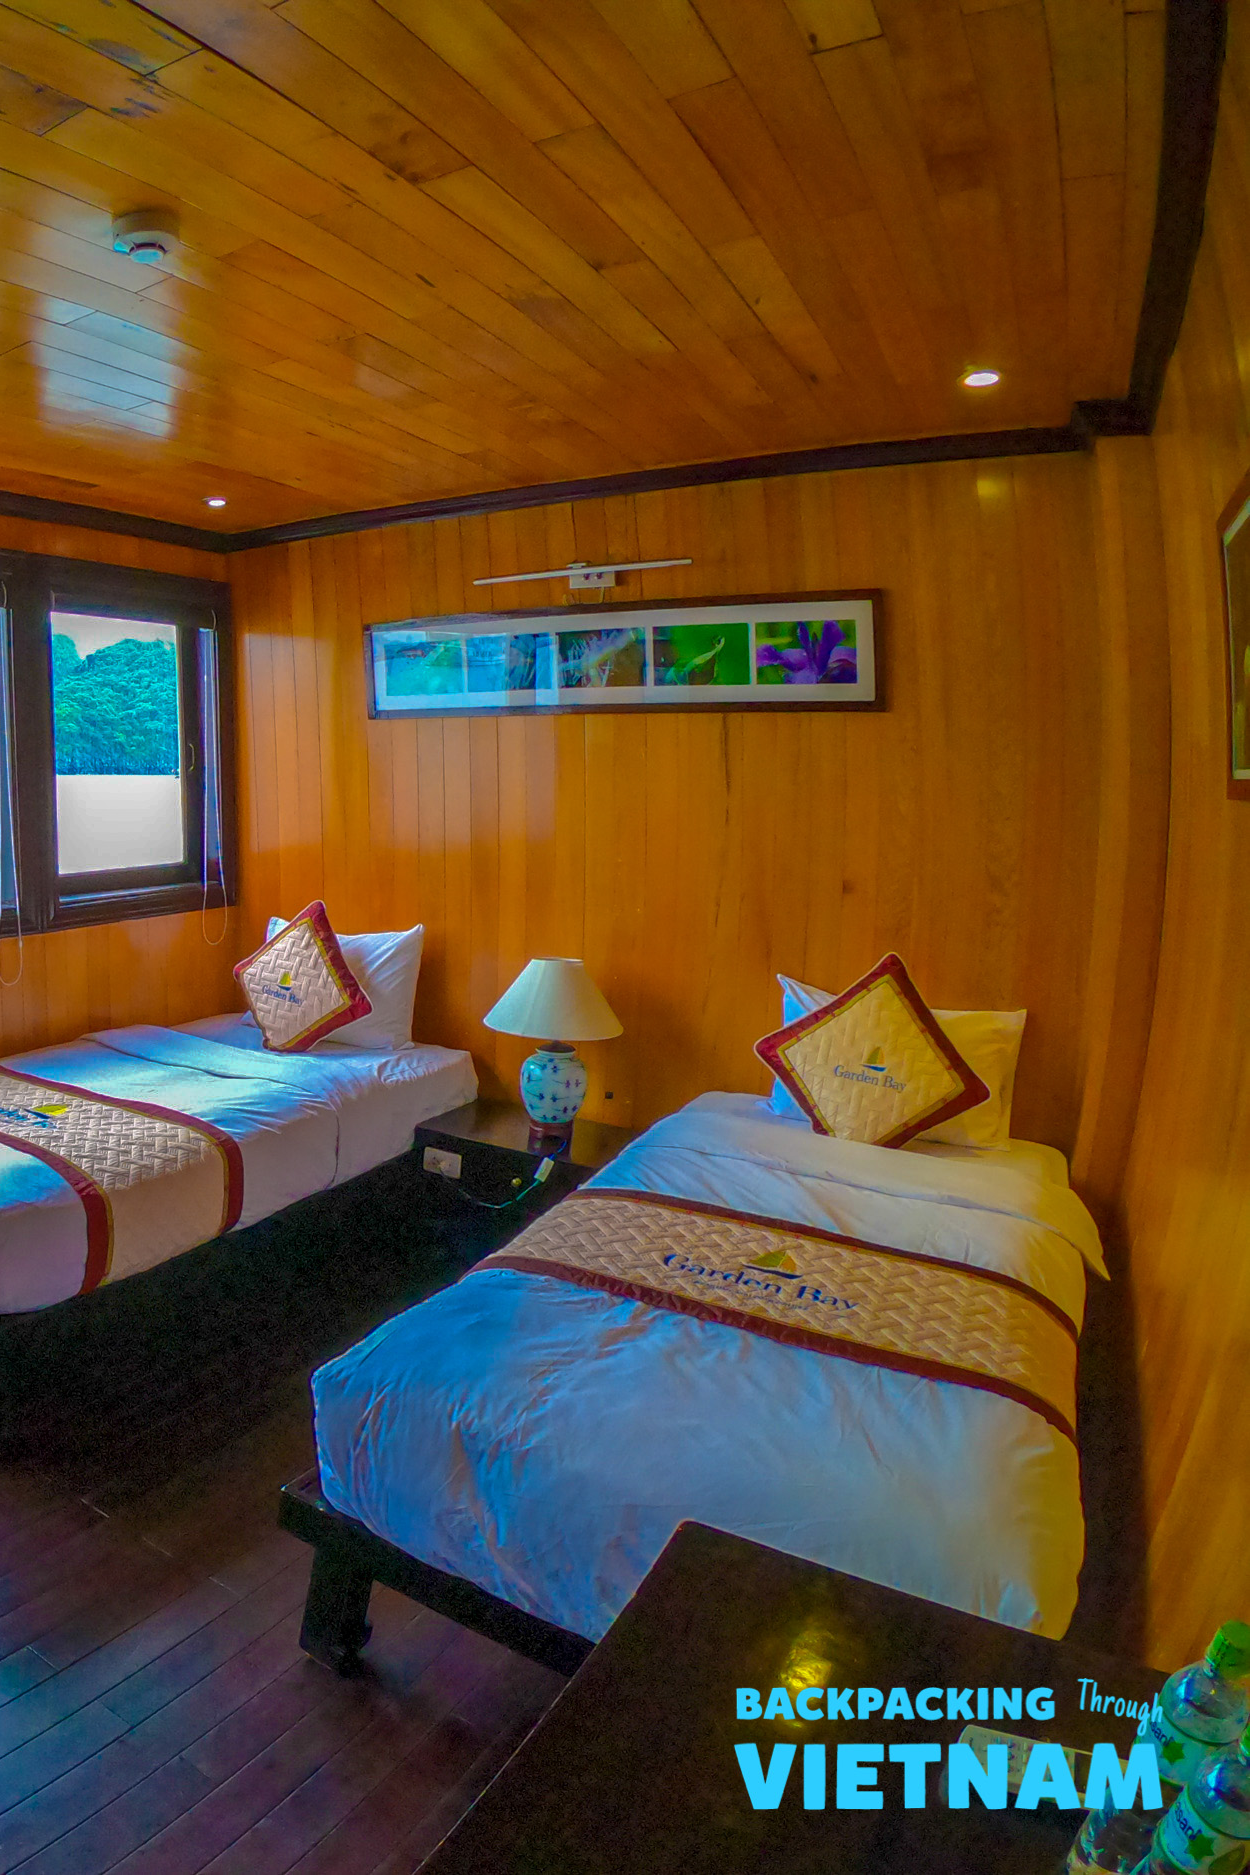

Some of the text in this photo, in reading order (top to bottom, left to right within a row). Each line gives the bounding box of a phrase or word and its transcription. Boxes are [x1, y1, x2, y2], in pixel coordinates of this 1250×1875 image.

[261, 984, 304, 1006] Garden Bay
[833, 1064, 907, 1093] Garden Bay
[663, 1253, 783, 1294] Garden
[796, 1285, 859, 1315] Bay
